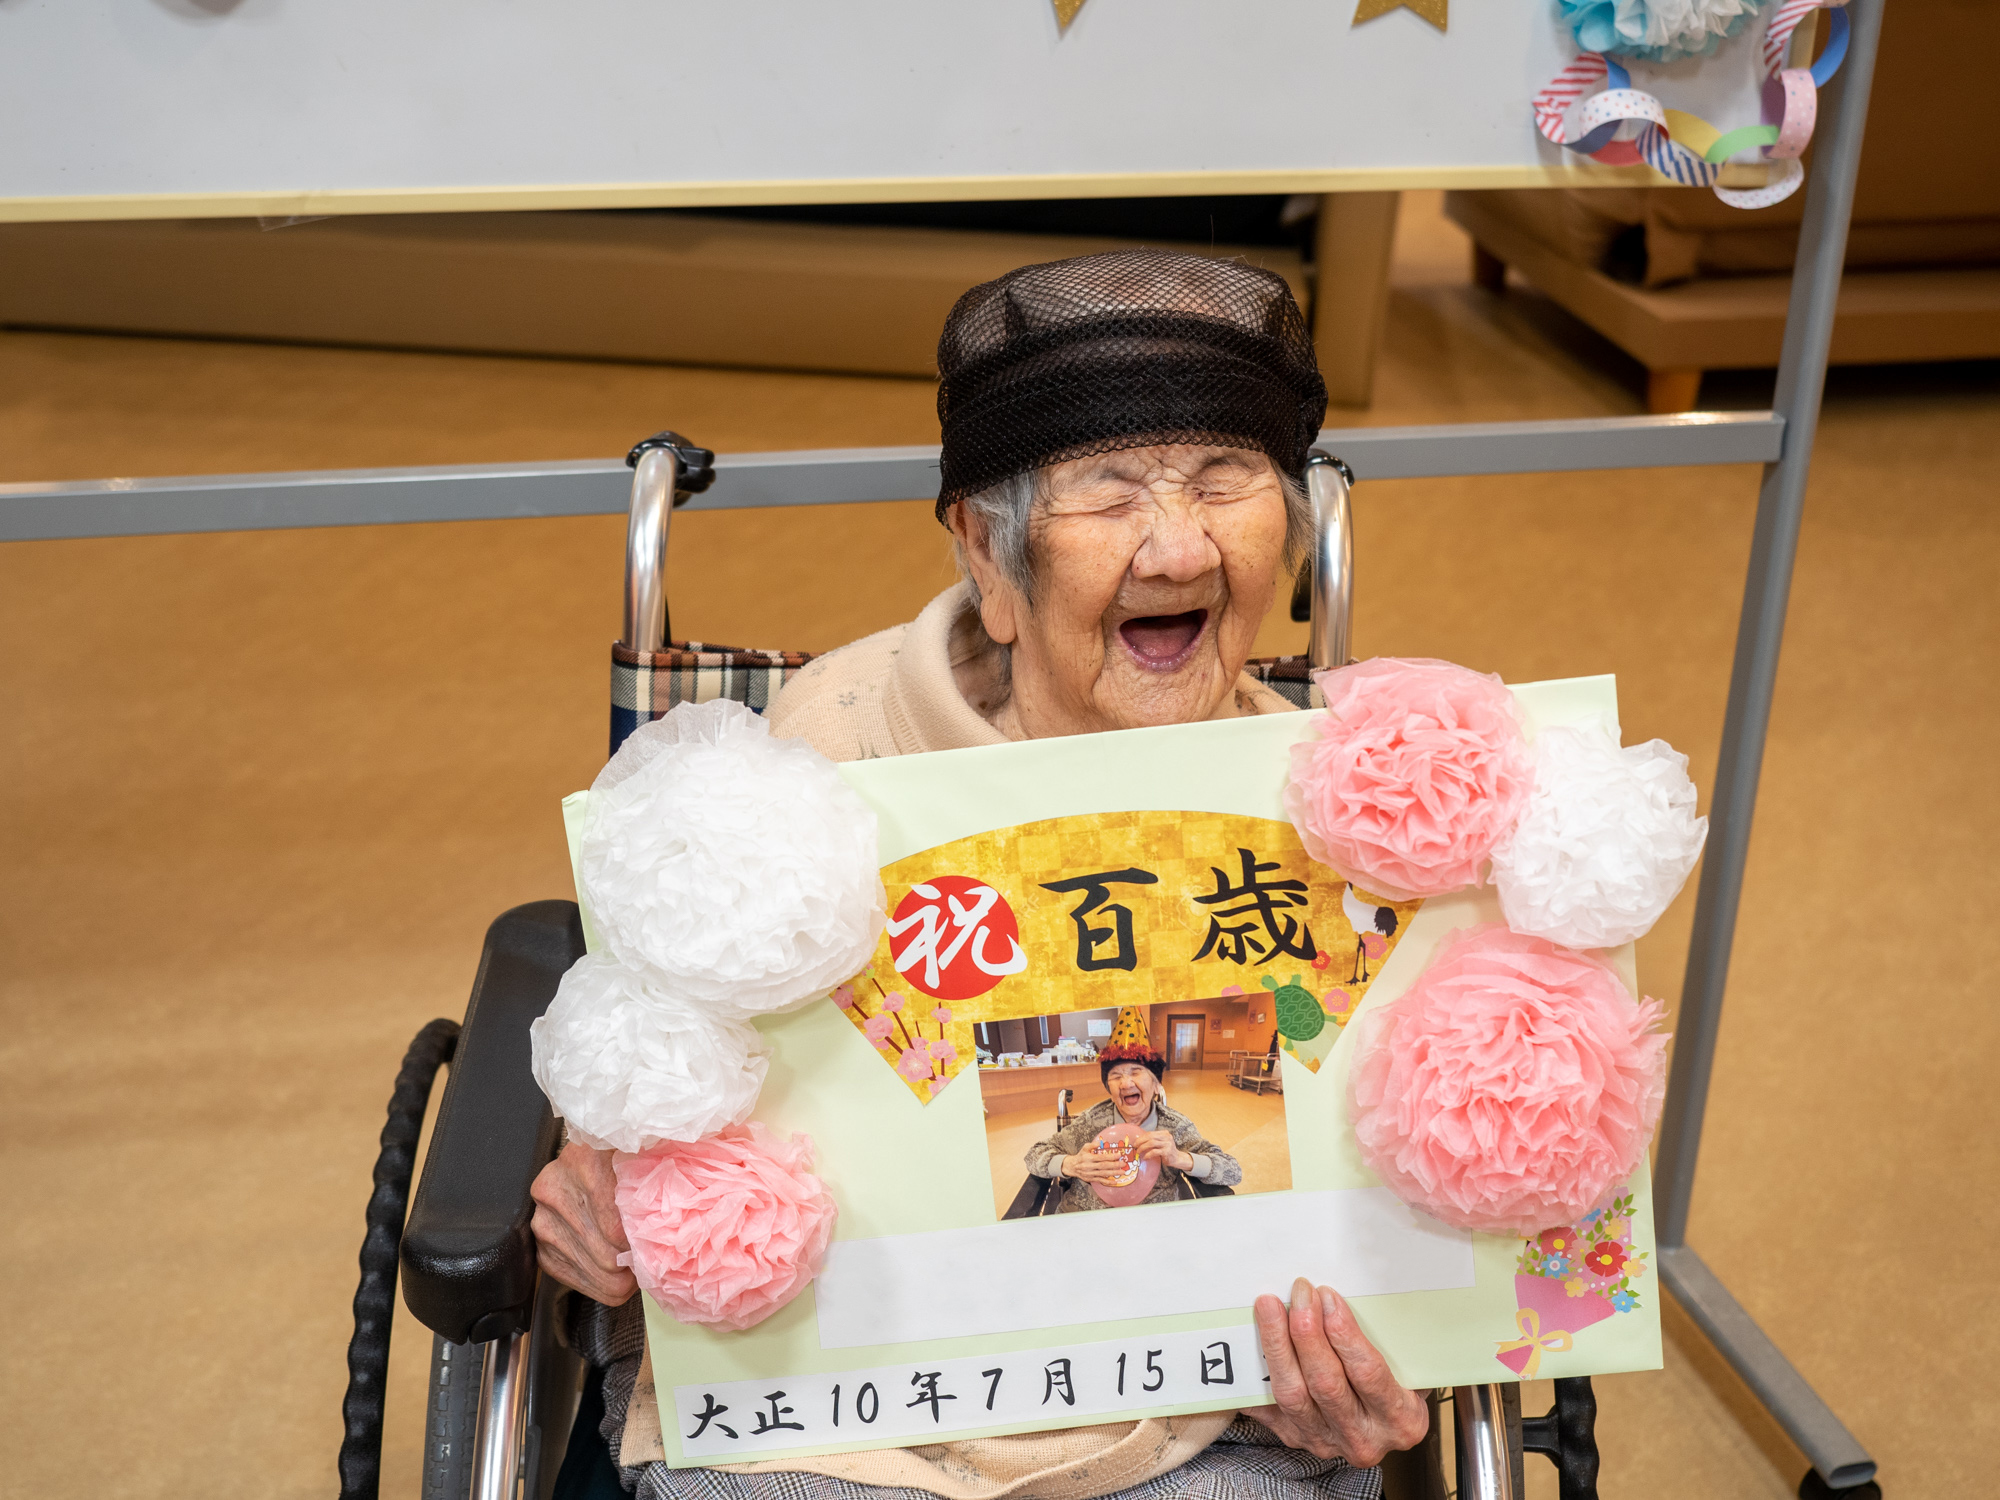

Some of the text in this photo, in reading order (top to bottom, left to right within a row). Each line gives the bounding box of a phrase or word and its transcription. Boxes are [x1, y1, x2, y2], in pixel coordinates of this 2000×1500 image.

[886, 847, 1318, 989] 祝 百歳
[686, 1341, 1271, 1440] 大正10年7月15日
